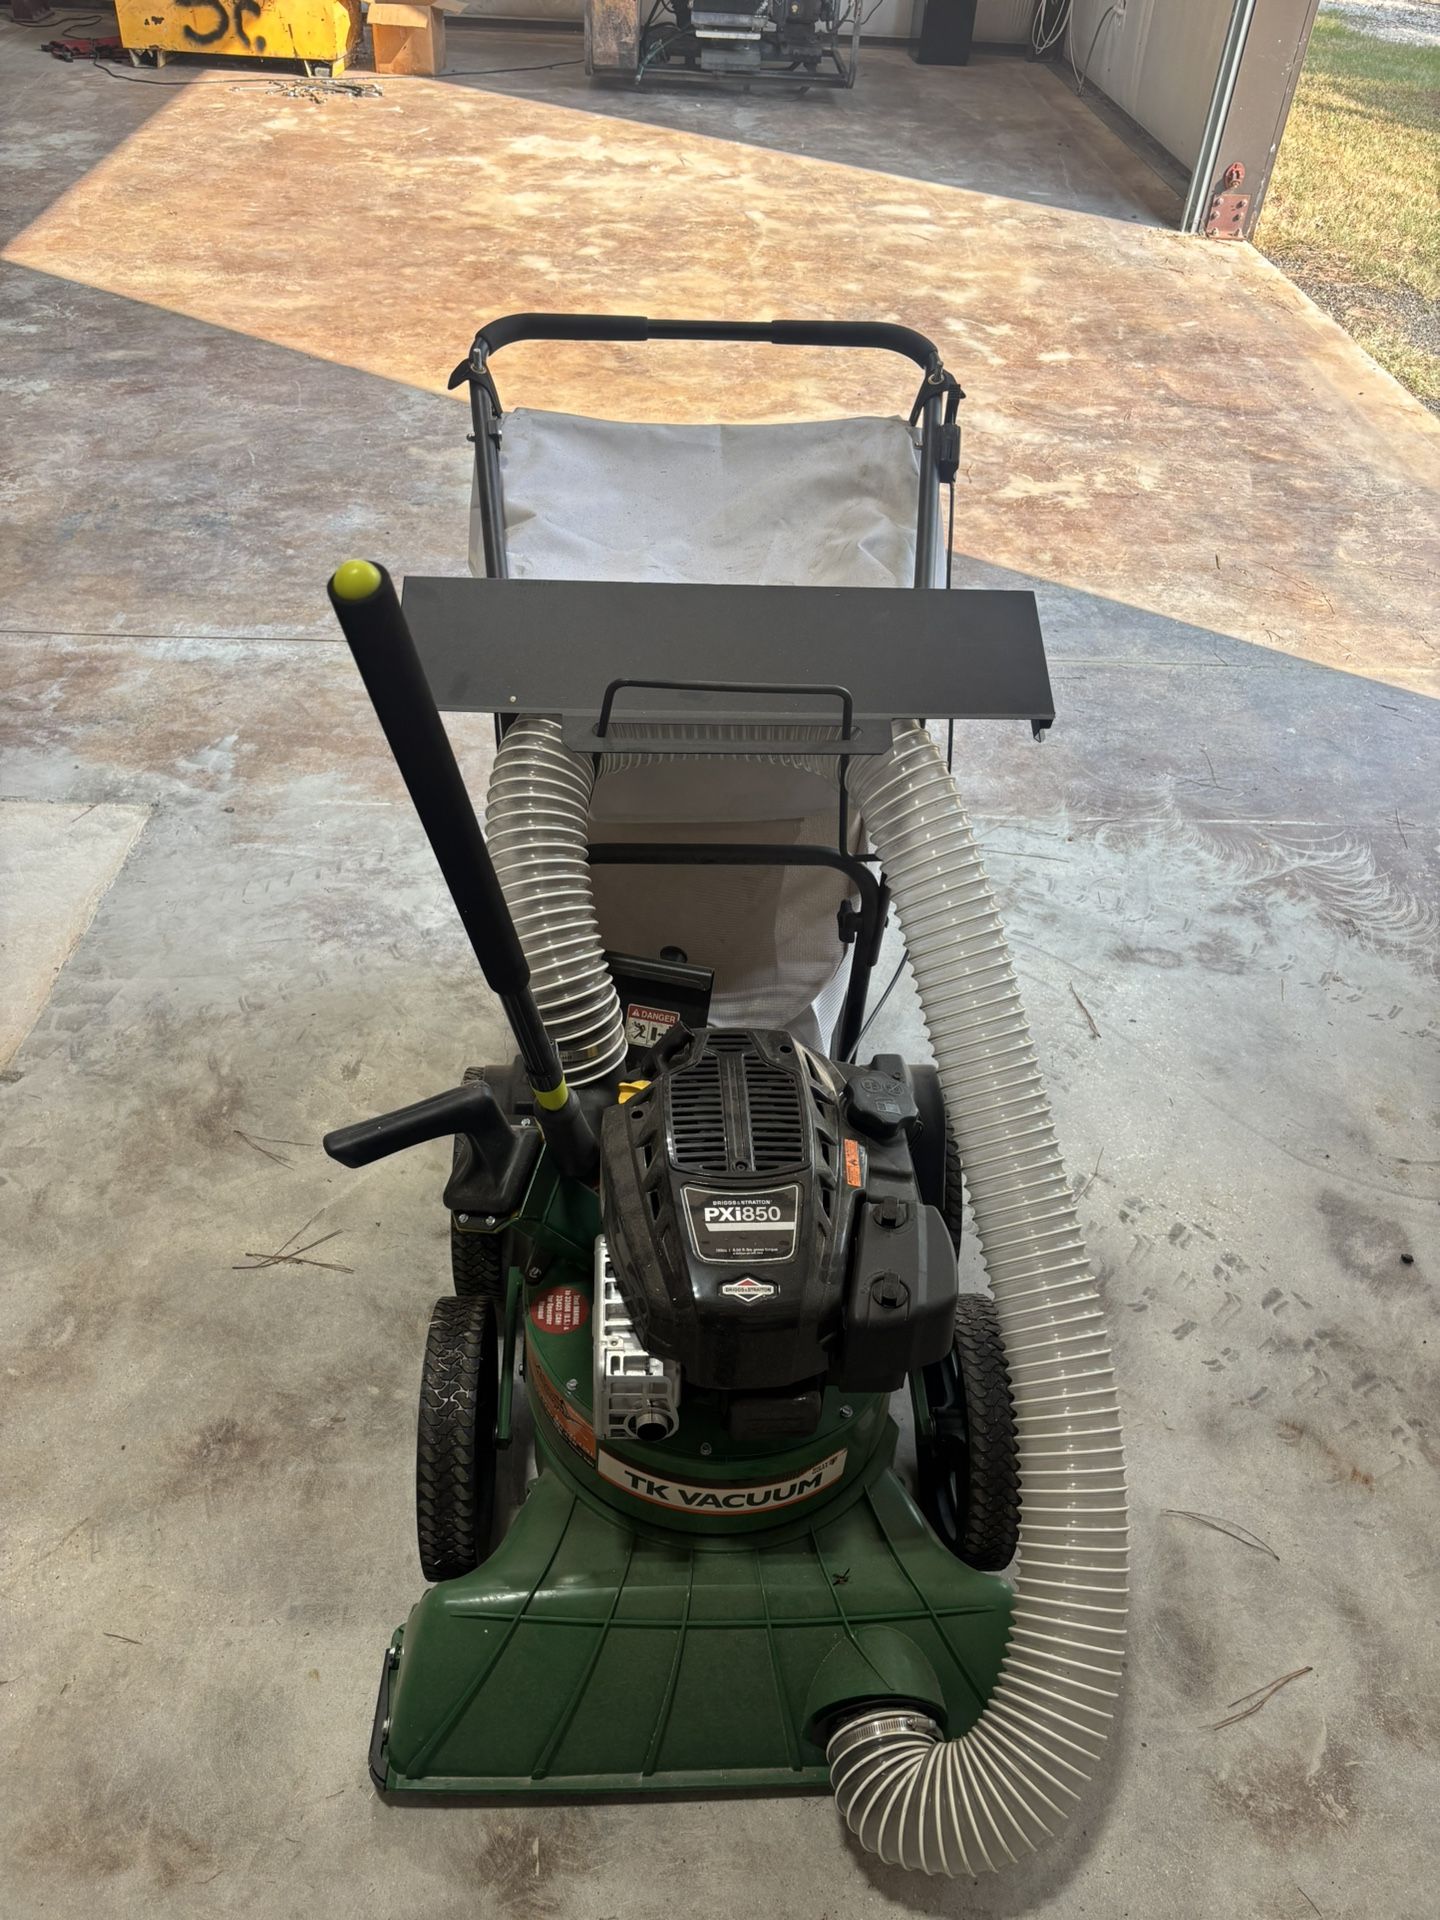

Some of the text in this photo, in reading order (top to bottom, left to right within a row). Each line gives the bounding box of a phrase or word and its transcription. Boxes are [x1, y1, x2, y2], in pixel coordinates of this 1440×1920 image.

[641, 1010, 676, 1023] DANGER
[704, 1206, 781, 1222] PXi850
[624, 1470, 823, 1509] TK VACUUM
